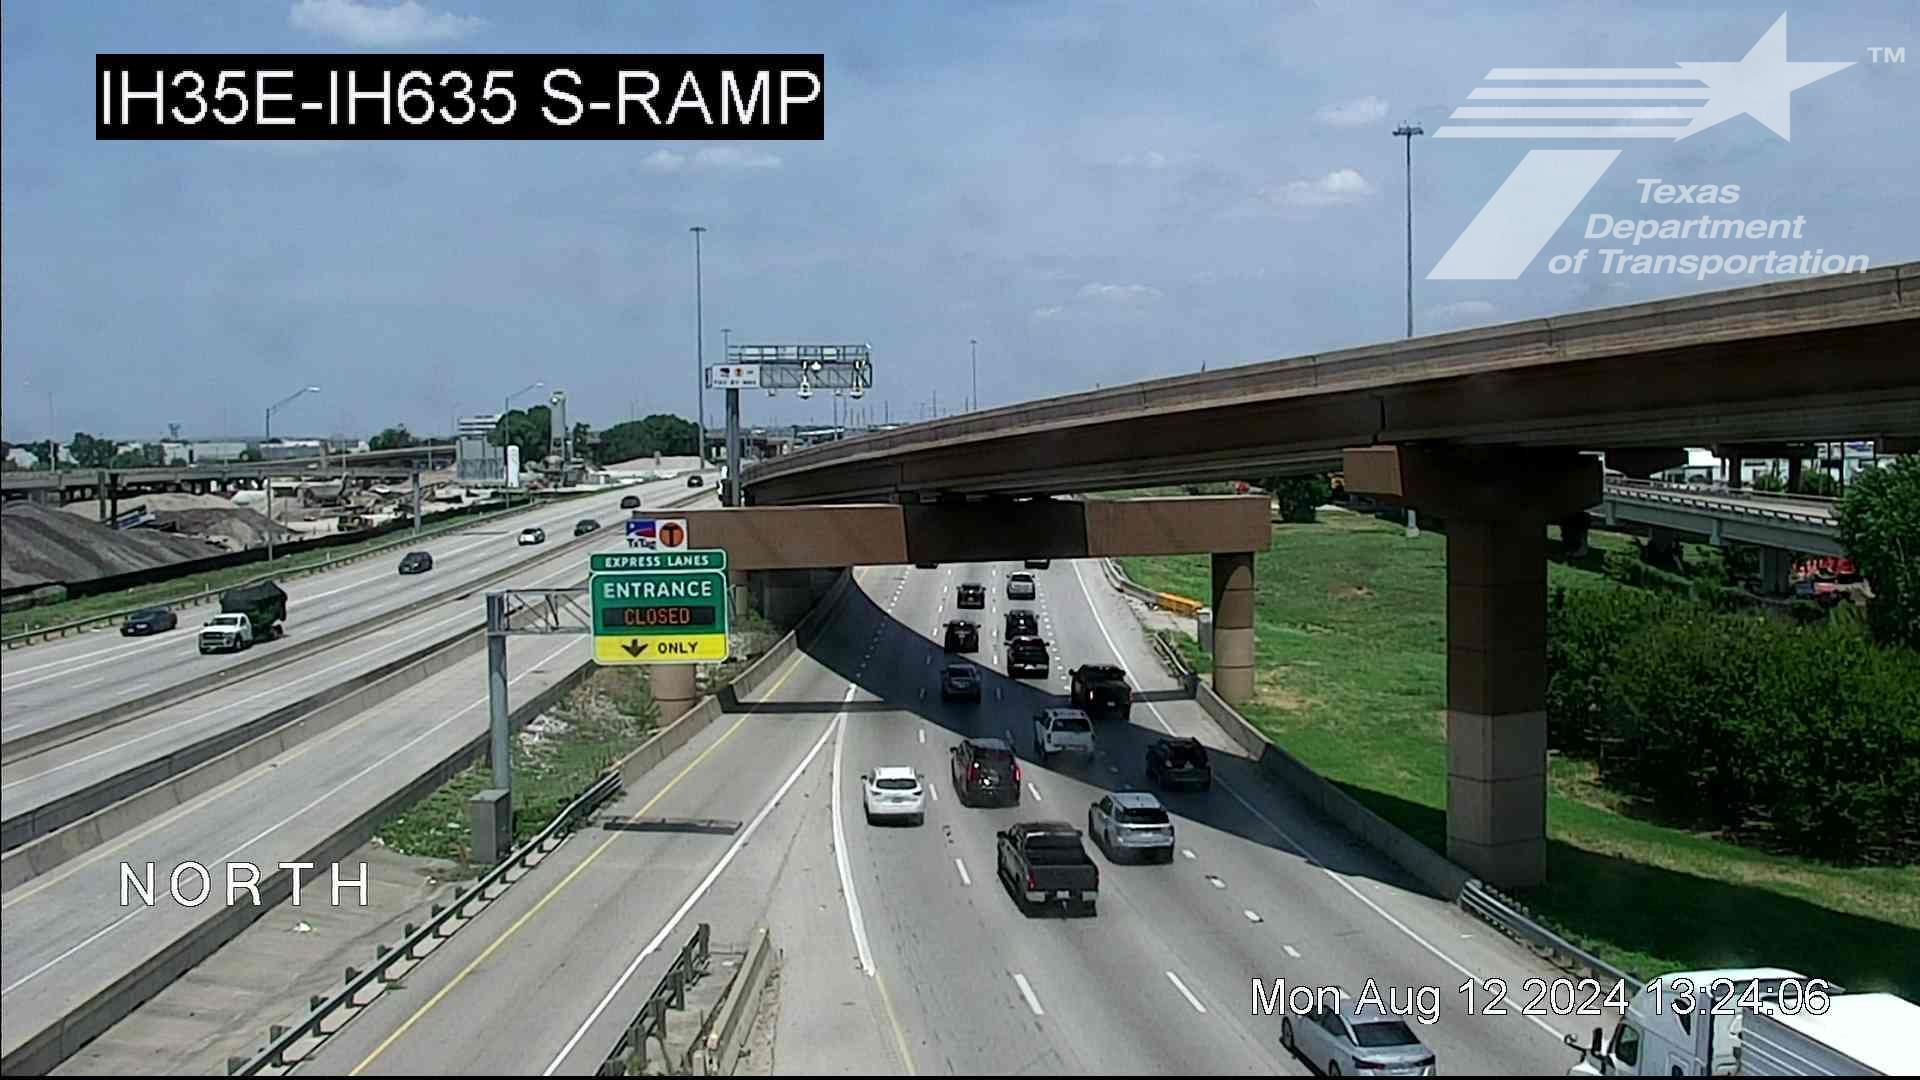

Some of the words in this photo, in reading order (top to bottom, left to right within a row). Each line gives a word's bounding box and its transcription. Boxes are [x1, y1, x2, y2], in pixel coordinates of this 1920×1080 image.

[605, 556, 660, 568] EXPRESS
[667, 555, 709, 567] LANES
[603, 580, 713, 599] ENTRANCE
[624, 607, 690, 625] CLOSED
[657, 642, 698, 654] ONLY
